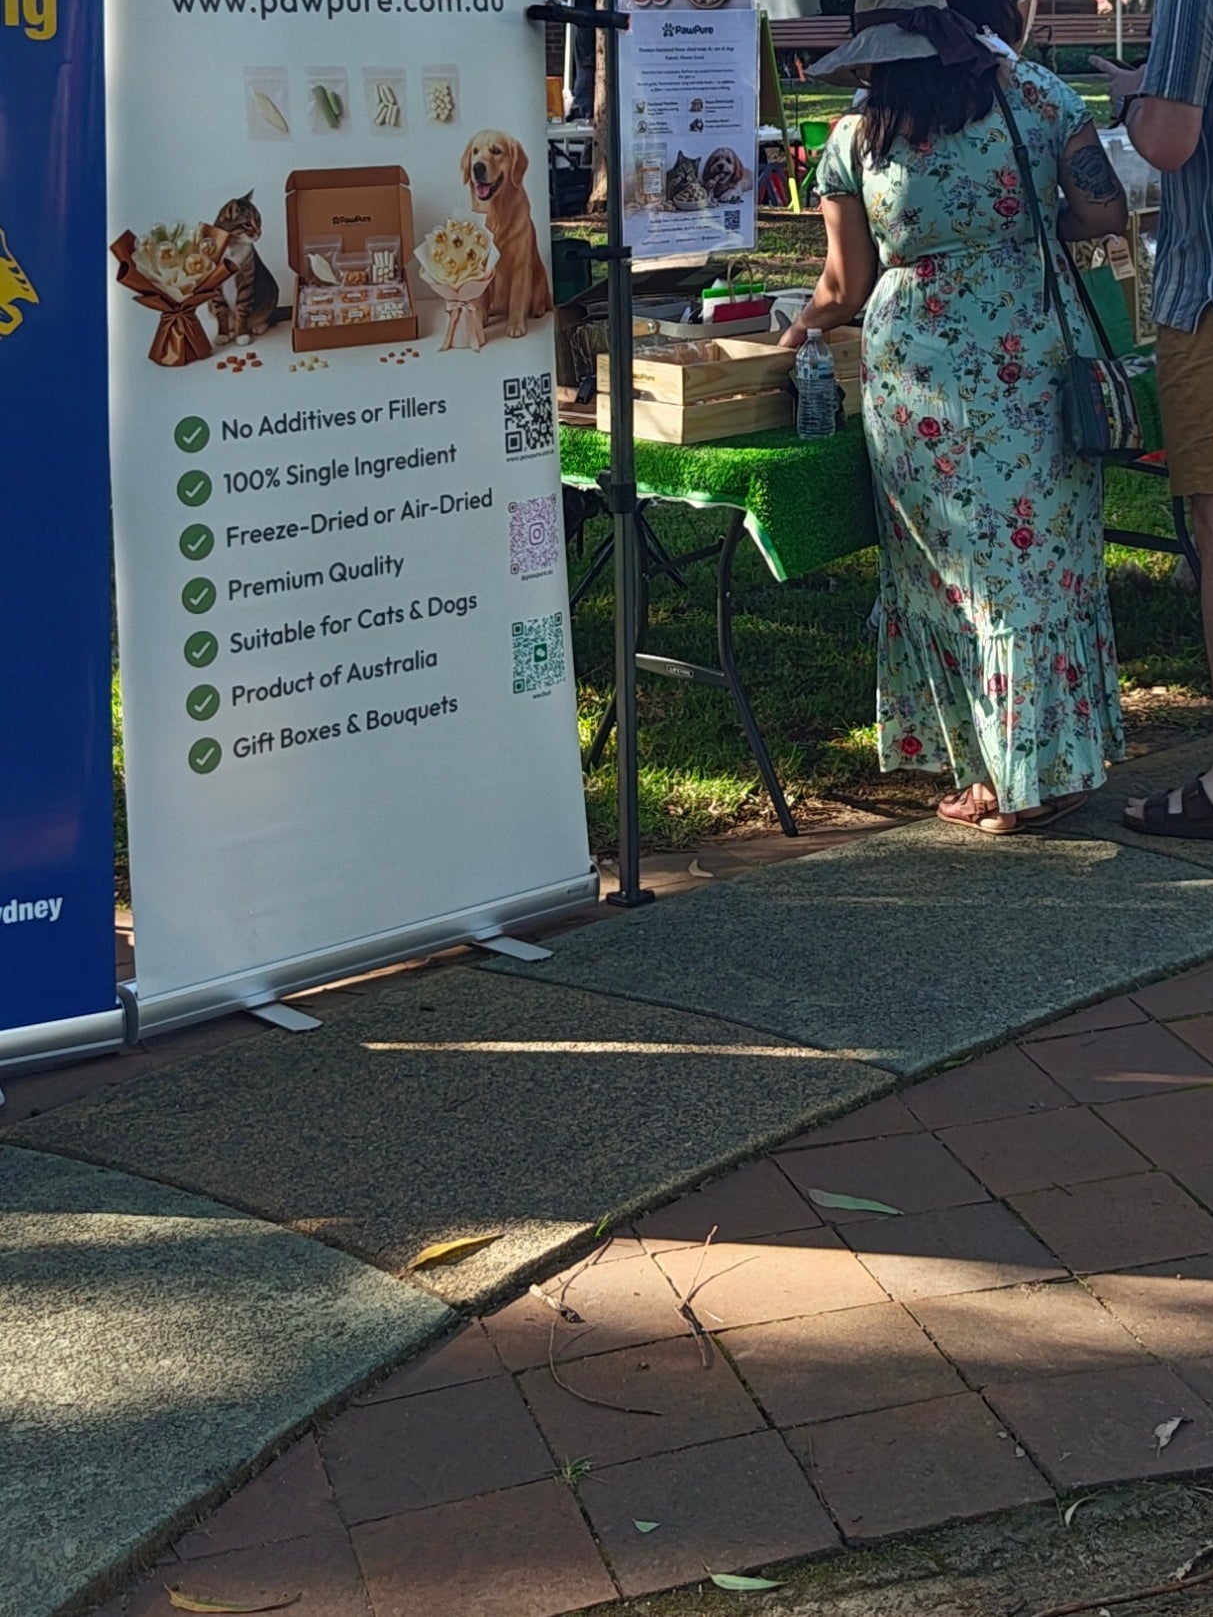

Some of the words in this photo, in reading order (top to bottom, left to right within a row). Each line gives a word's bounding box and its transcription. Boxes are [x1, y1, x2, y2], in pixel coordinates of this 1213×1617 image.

[222, 419, 253, 441] No
[258, 409, 357, 437] Additives
[361, 407, 383, 423] or
[389, 397, 447, 420] Fillers
[223, 465, 281, 494] 100%
[286, 459, 349, 486] Single
[355, 444, 457, 479] Ingredient
[226, 506, 369, 547] Freeze-Dried
[374, 508, 396, 525] or
[400, 487, 493, 521] Air-Dried
[228, 571, 324, 601] Premium
[329, 554, 404, 583] Quality
[230, 620, 316, 654] Suitable
[320, 615, 352, 637] for
[357, 606, 404, 630] Cats
[409, 600, 424, 620] &
[428, 595, 477, 622] Dogs
[232, 671, 315, 706] Product
[320, 664, 343, 688] of
[346, 650, 437, 683] Australia
[233, 731, 275, 759] Gift
[281, 723, 341, 750] Boxes
[346, 713, 361, 734] &
[367, 693, 458, 730] Bouquets
[0, 897, 63, 924] dney
